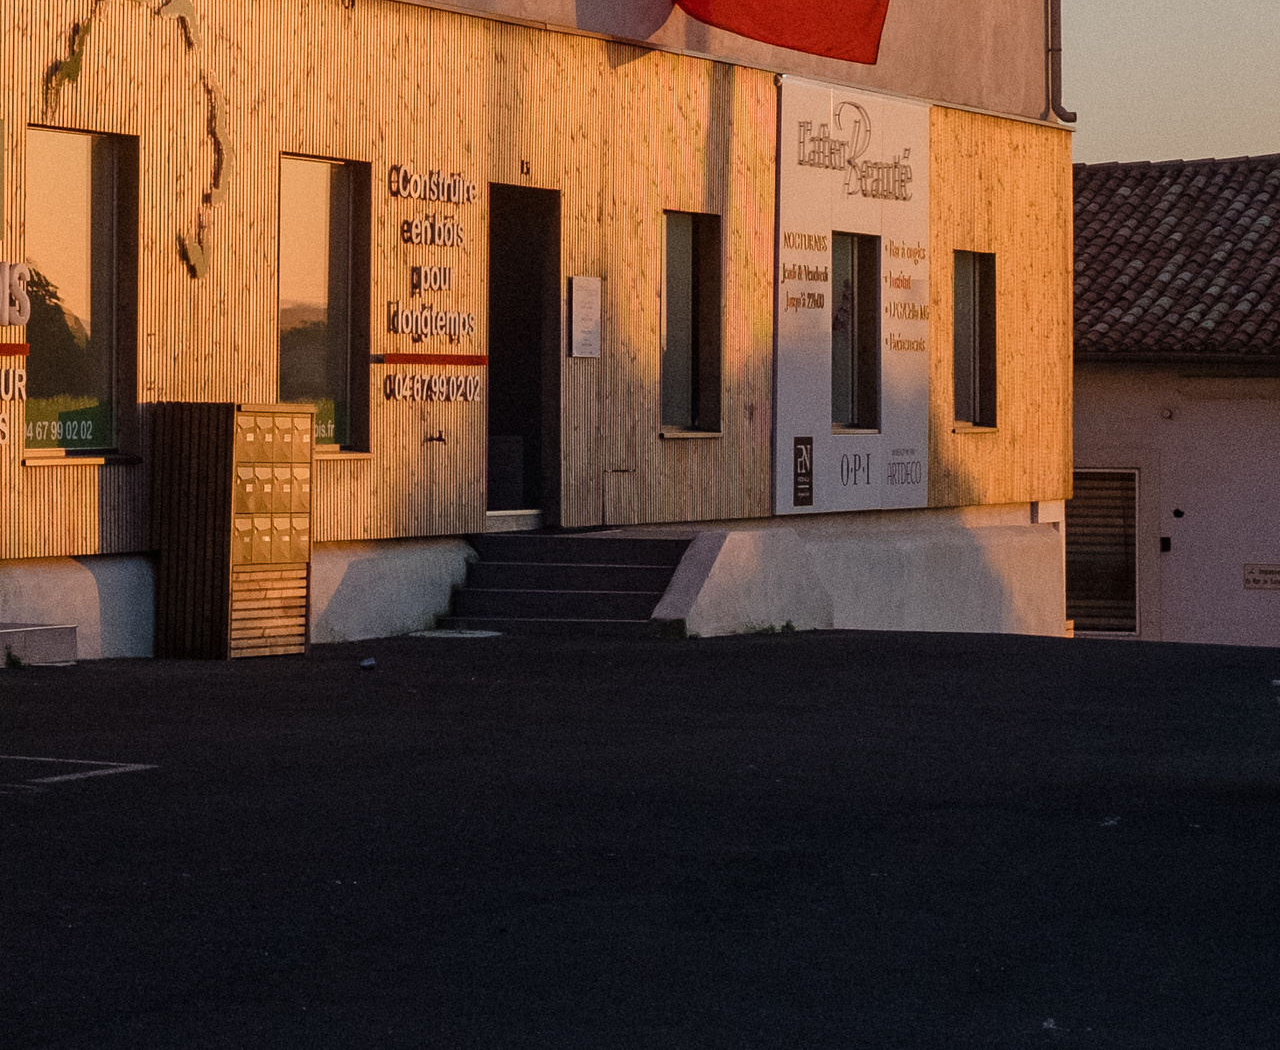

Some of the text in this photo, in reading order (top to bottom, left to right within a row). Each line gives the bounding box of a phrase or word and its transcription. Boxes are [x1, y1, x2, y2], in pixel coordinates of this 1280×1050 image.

[399, 164, 478, 204] Construire
[412, 215, 464, 247] en bois
[421, 264, 454, 295] pour
[398, 302, 475, 343] longtemps
[394, 373, 480, 401] 04 67 99 02 02
[36, 421, 49, 440] 67
[51, 421, 63, 440] 99
[66, 420, 78, 440] 02
[80, 420, 93, 440] 02
[886, 461, 922, 486] ARTDECO
